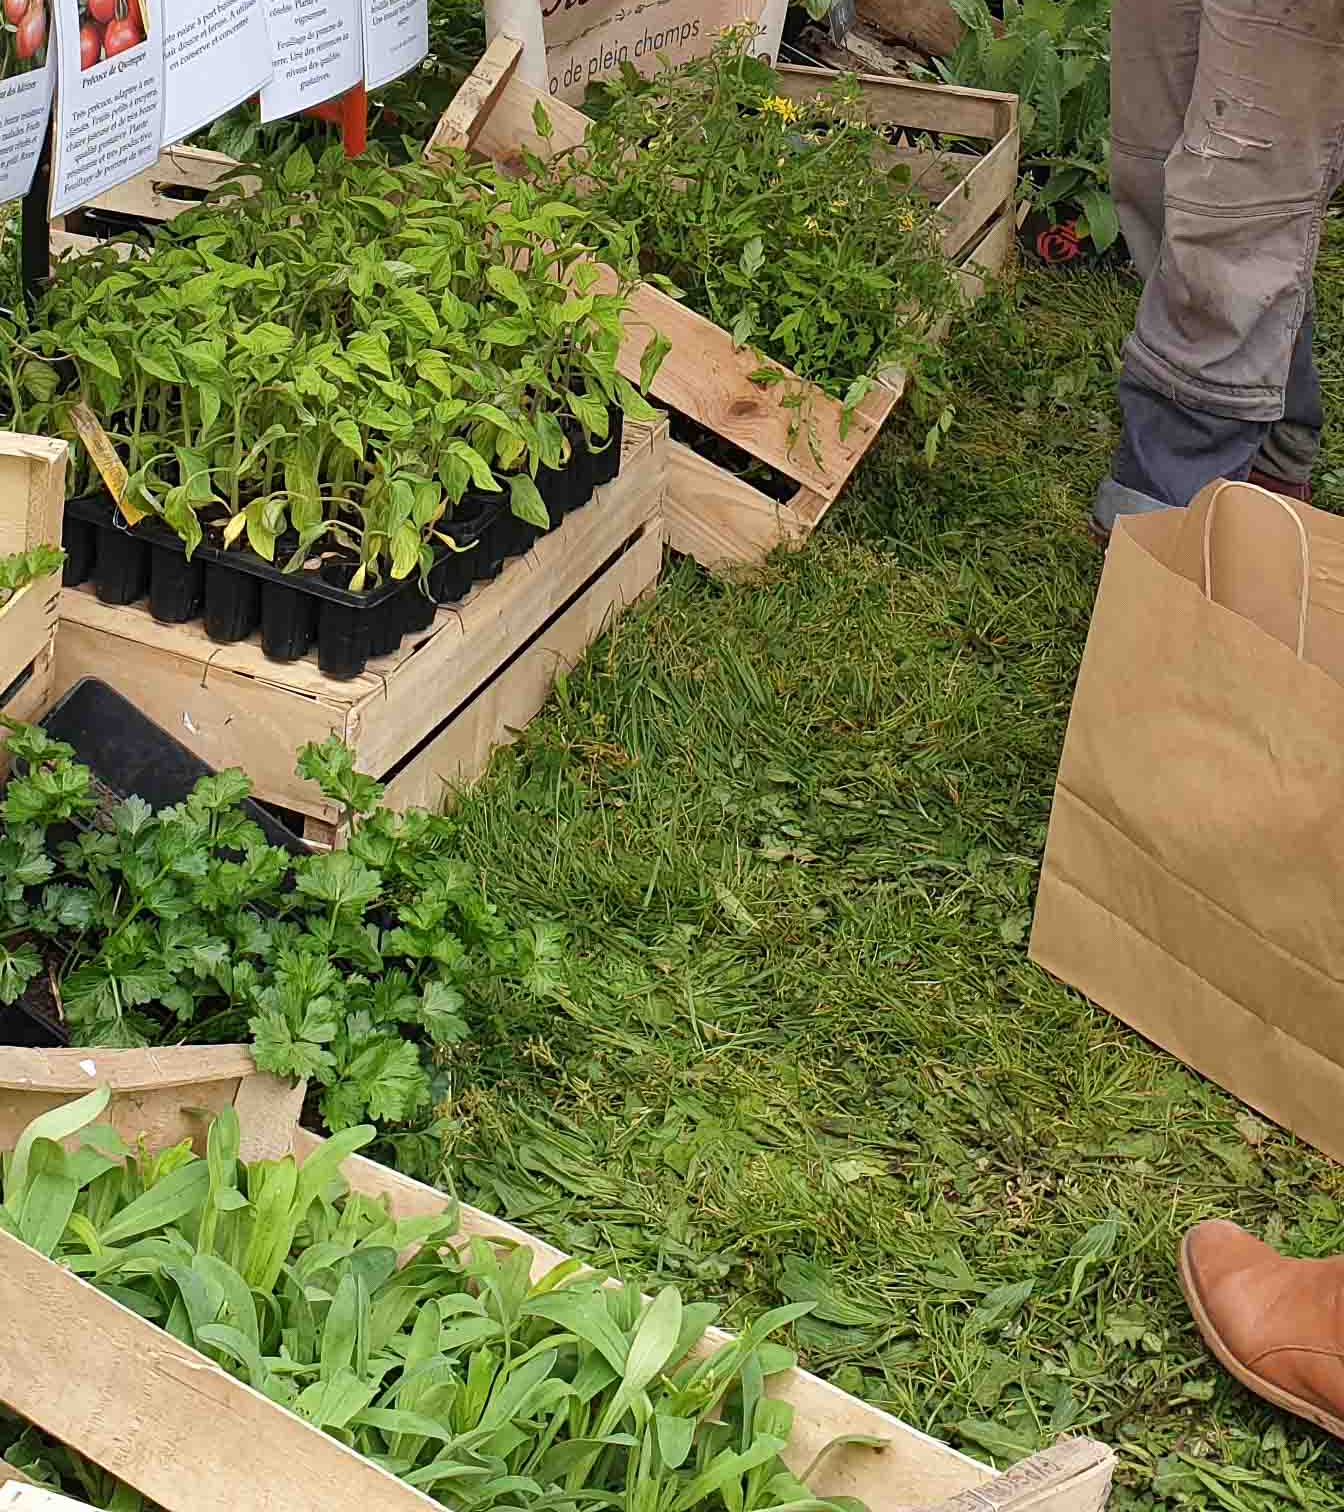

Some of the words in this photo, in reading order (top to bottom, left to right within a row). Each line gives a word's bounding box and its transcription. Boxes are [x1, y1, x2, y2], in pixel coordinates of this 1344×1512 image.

[562, 57, 583, 88] de
[587, 44, 629, 84] plein
[634, 16, 702, 60] champs
